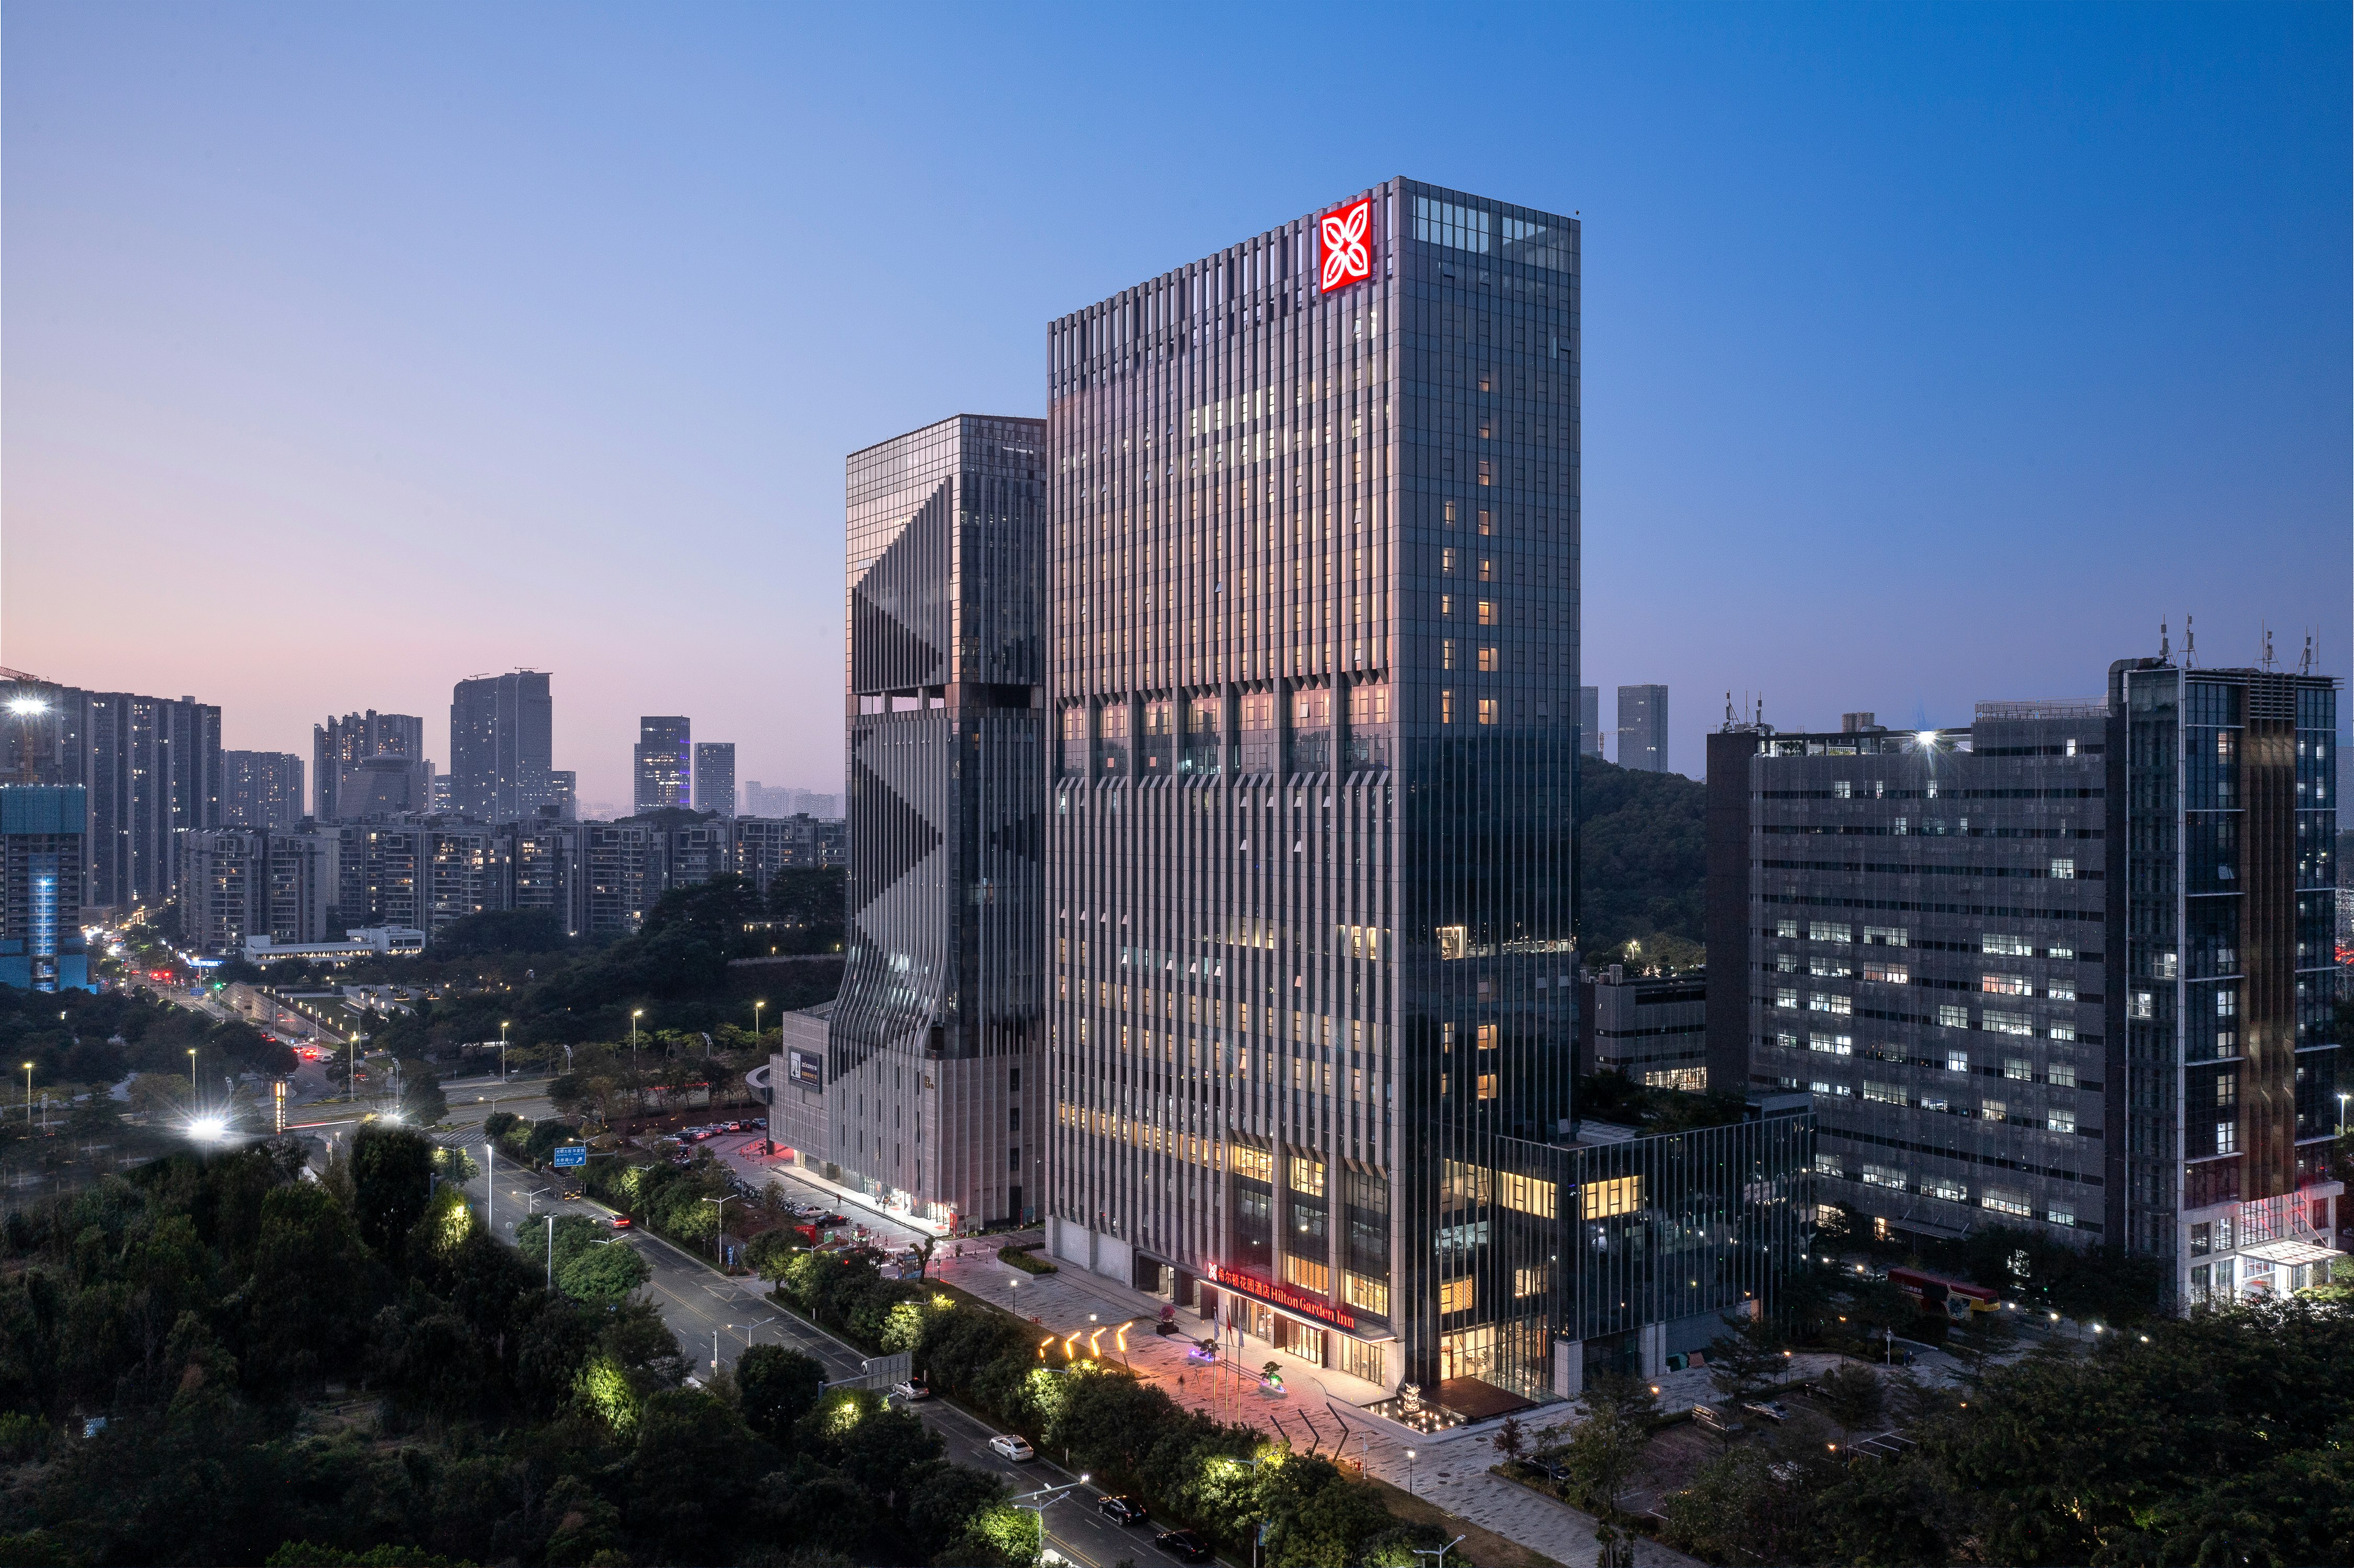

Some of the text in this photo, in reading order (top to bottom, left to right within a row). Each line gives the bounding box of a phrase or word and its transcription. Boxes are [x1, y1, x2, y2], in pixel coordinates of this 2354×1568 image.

[1218, 1267, 1354, 1329] 希尔顿花园酒店 Hilton Garden Inn
